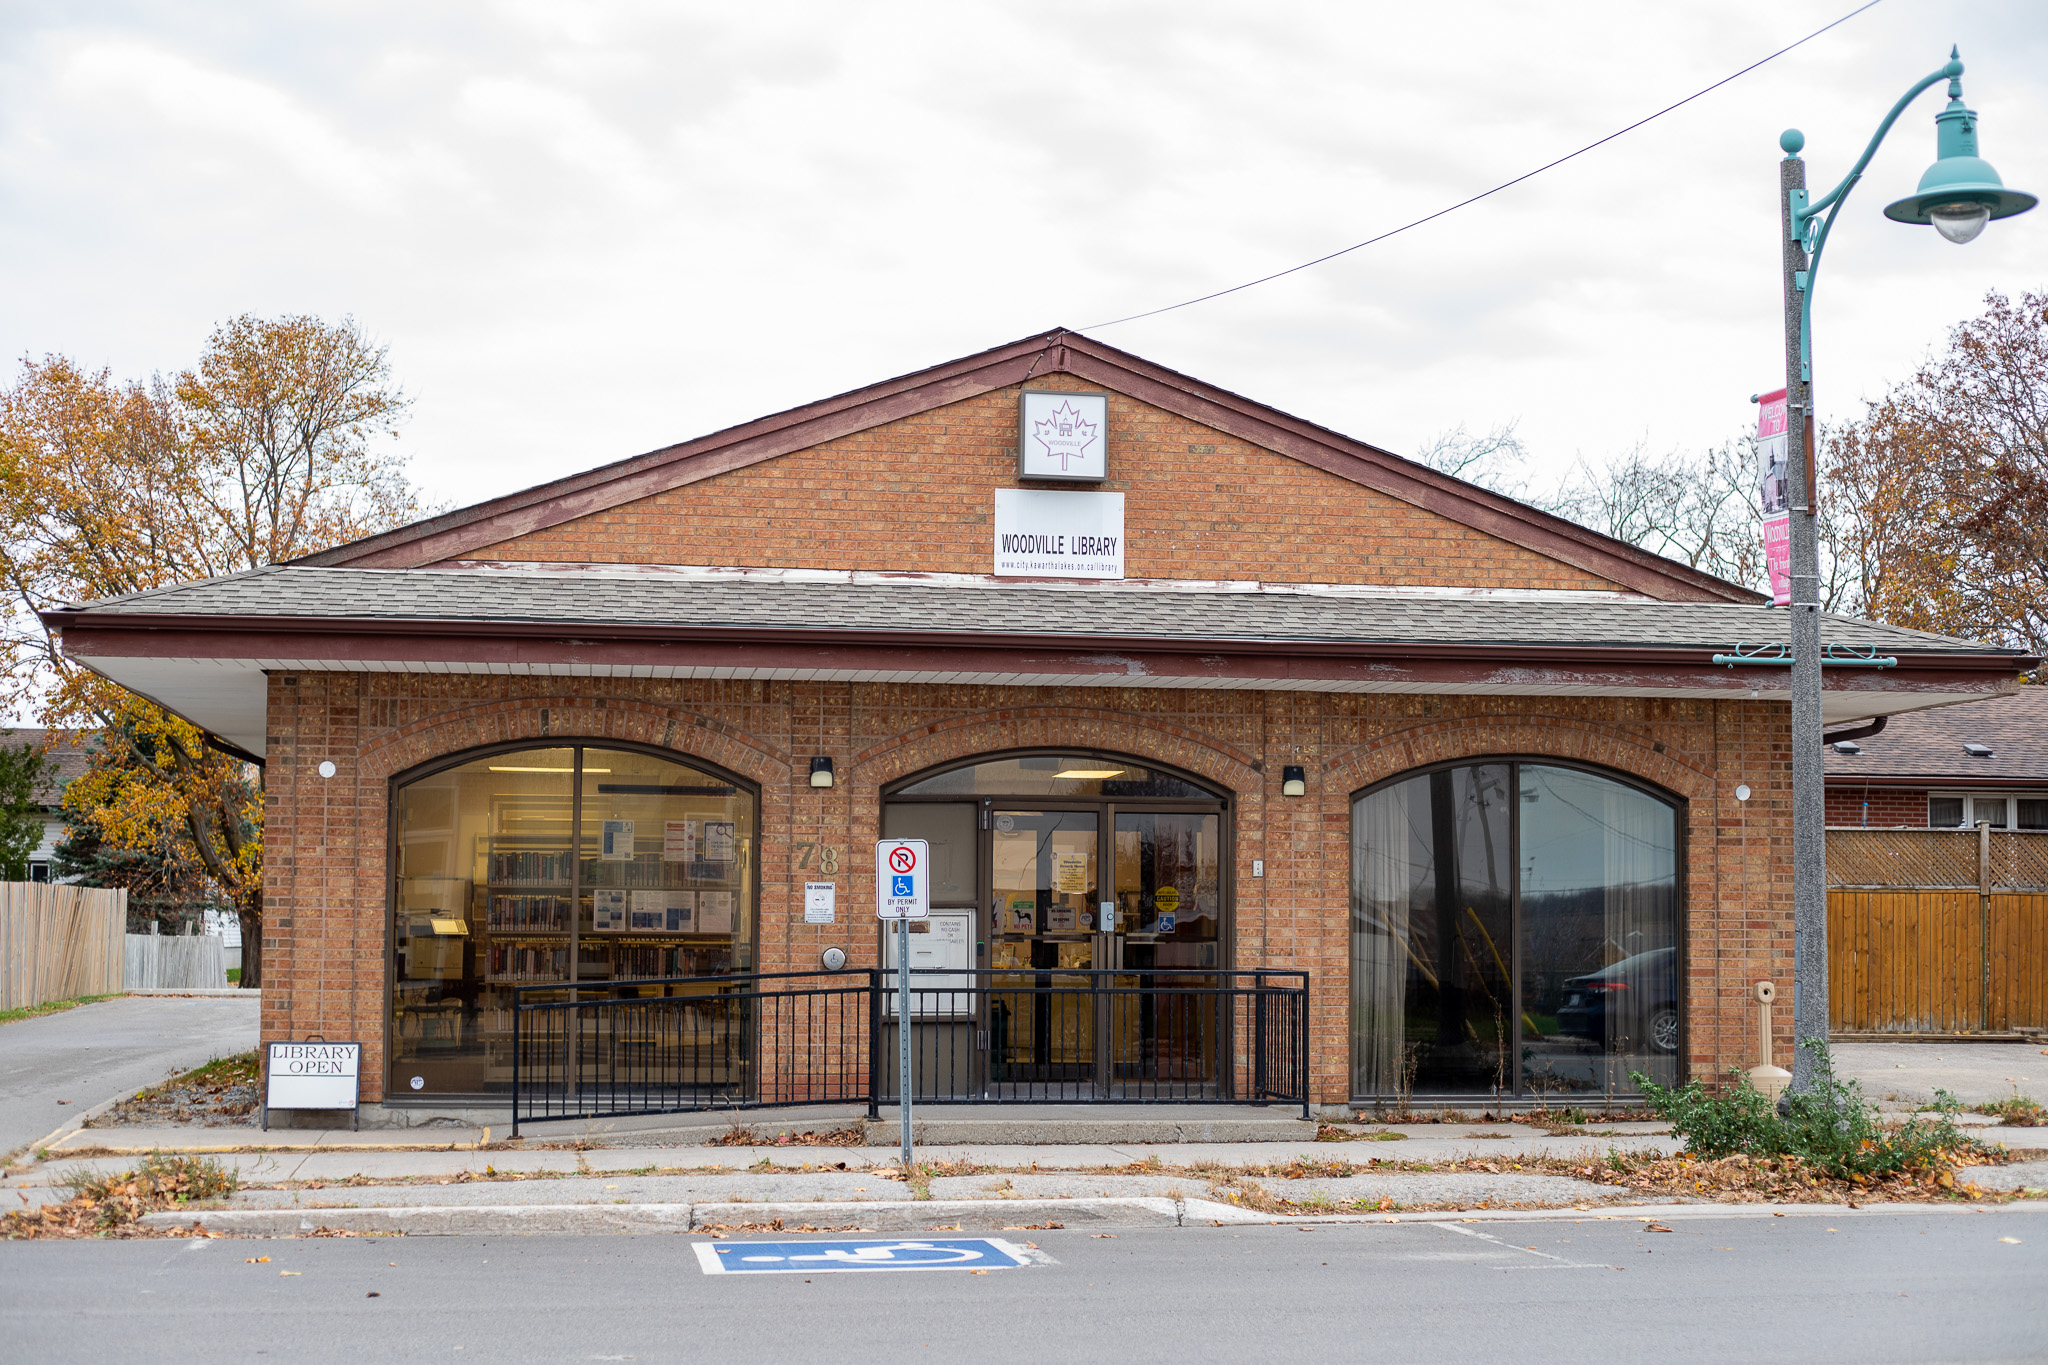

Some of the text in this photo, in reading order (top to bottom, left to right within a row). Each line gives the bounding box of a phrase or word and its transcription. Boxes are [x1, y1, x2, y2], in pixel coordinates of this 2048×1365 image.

[1761, 403, 1787, 421] WELCOM
[1772, 419, 1781, 433] TO
[1002, 534, 1117, 556] WOODVILLE LIBRARY
[796, 842, 839, 875] 78
[272, 1046, 356, 1059] LIBRARY
[289, 1060, 343, 1074] OPEN
